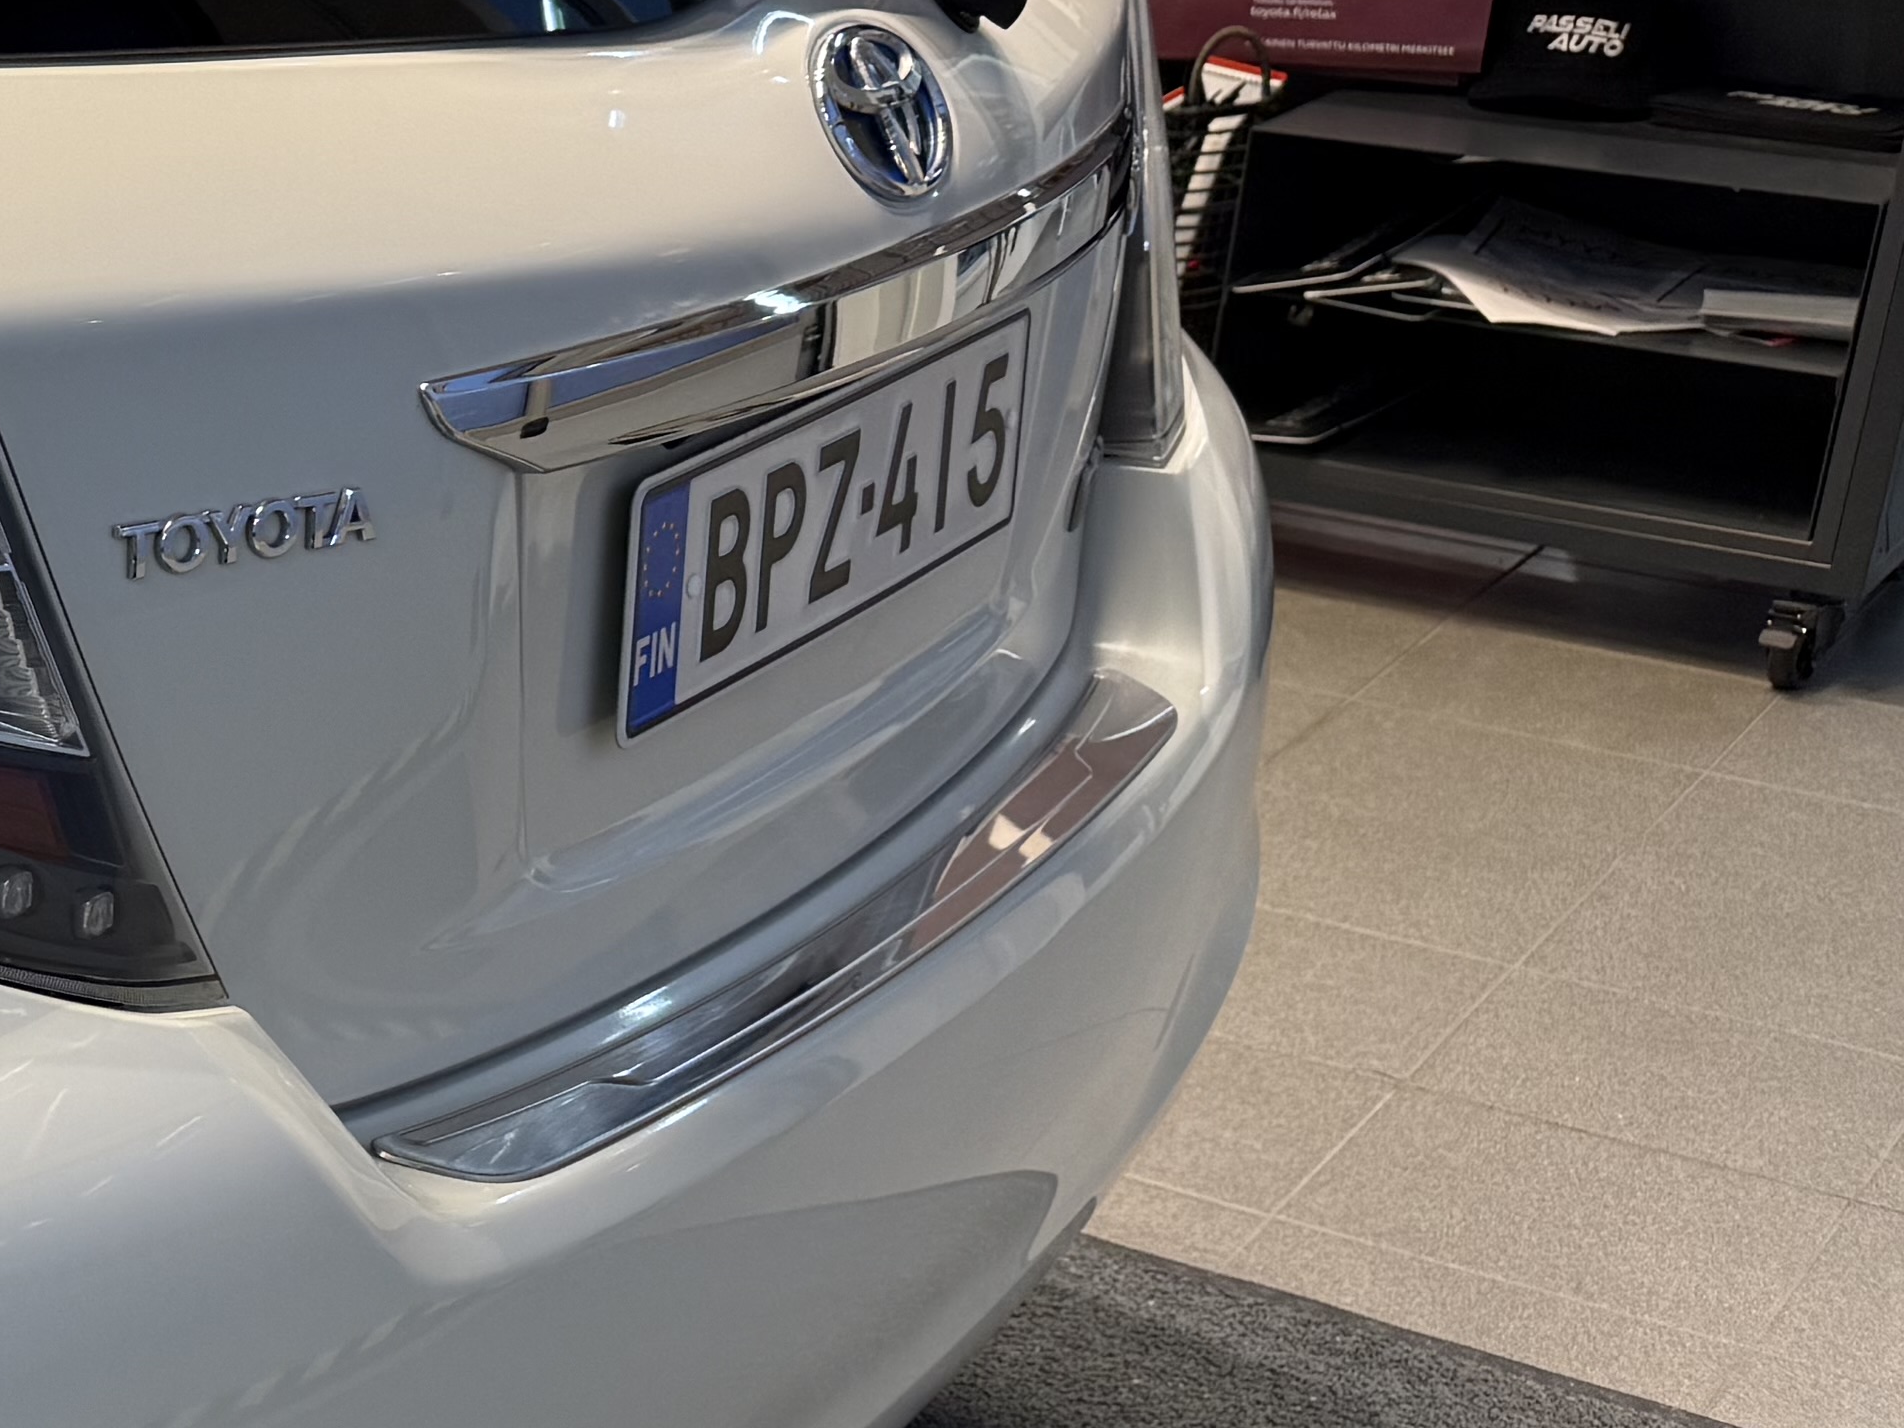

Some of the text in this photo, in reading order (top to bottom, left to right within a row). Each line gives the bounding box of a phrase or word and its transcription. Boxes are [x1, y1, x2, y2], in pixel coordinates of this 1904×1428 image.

[1526, 13, 1632, 40] PASSELI
[1546, 32, 1627, 59] AUTO
[111, 486, 377, 580] TOYOTA
[699, 352, 1010, 663] BPZ-415
[632, 620, 678, 688] FIN
